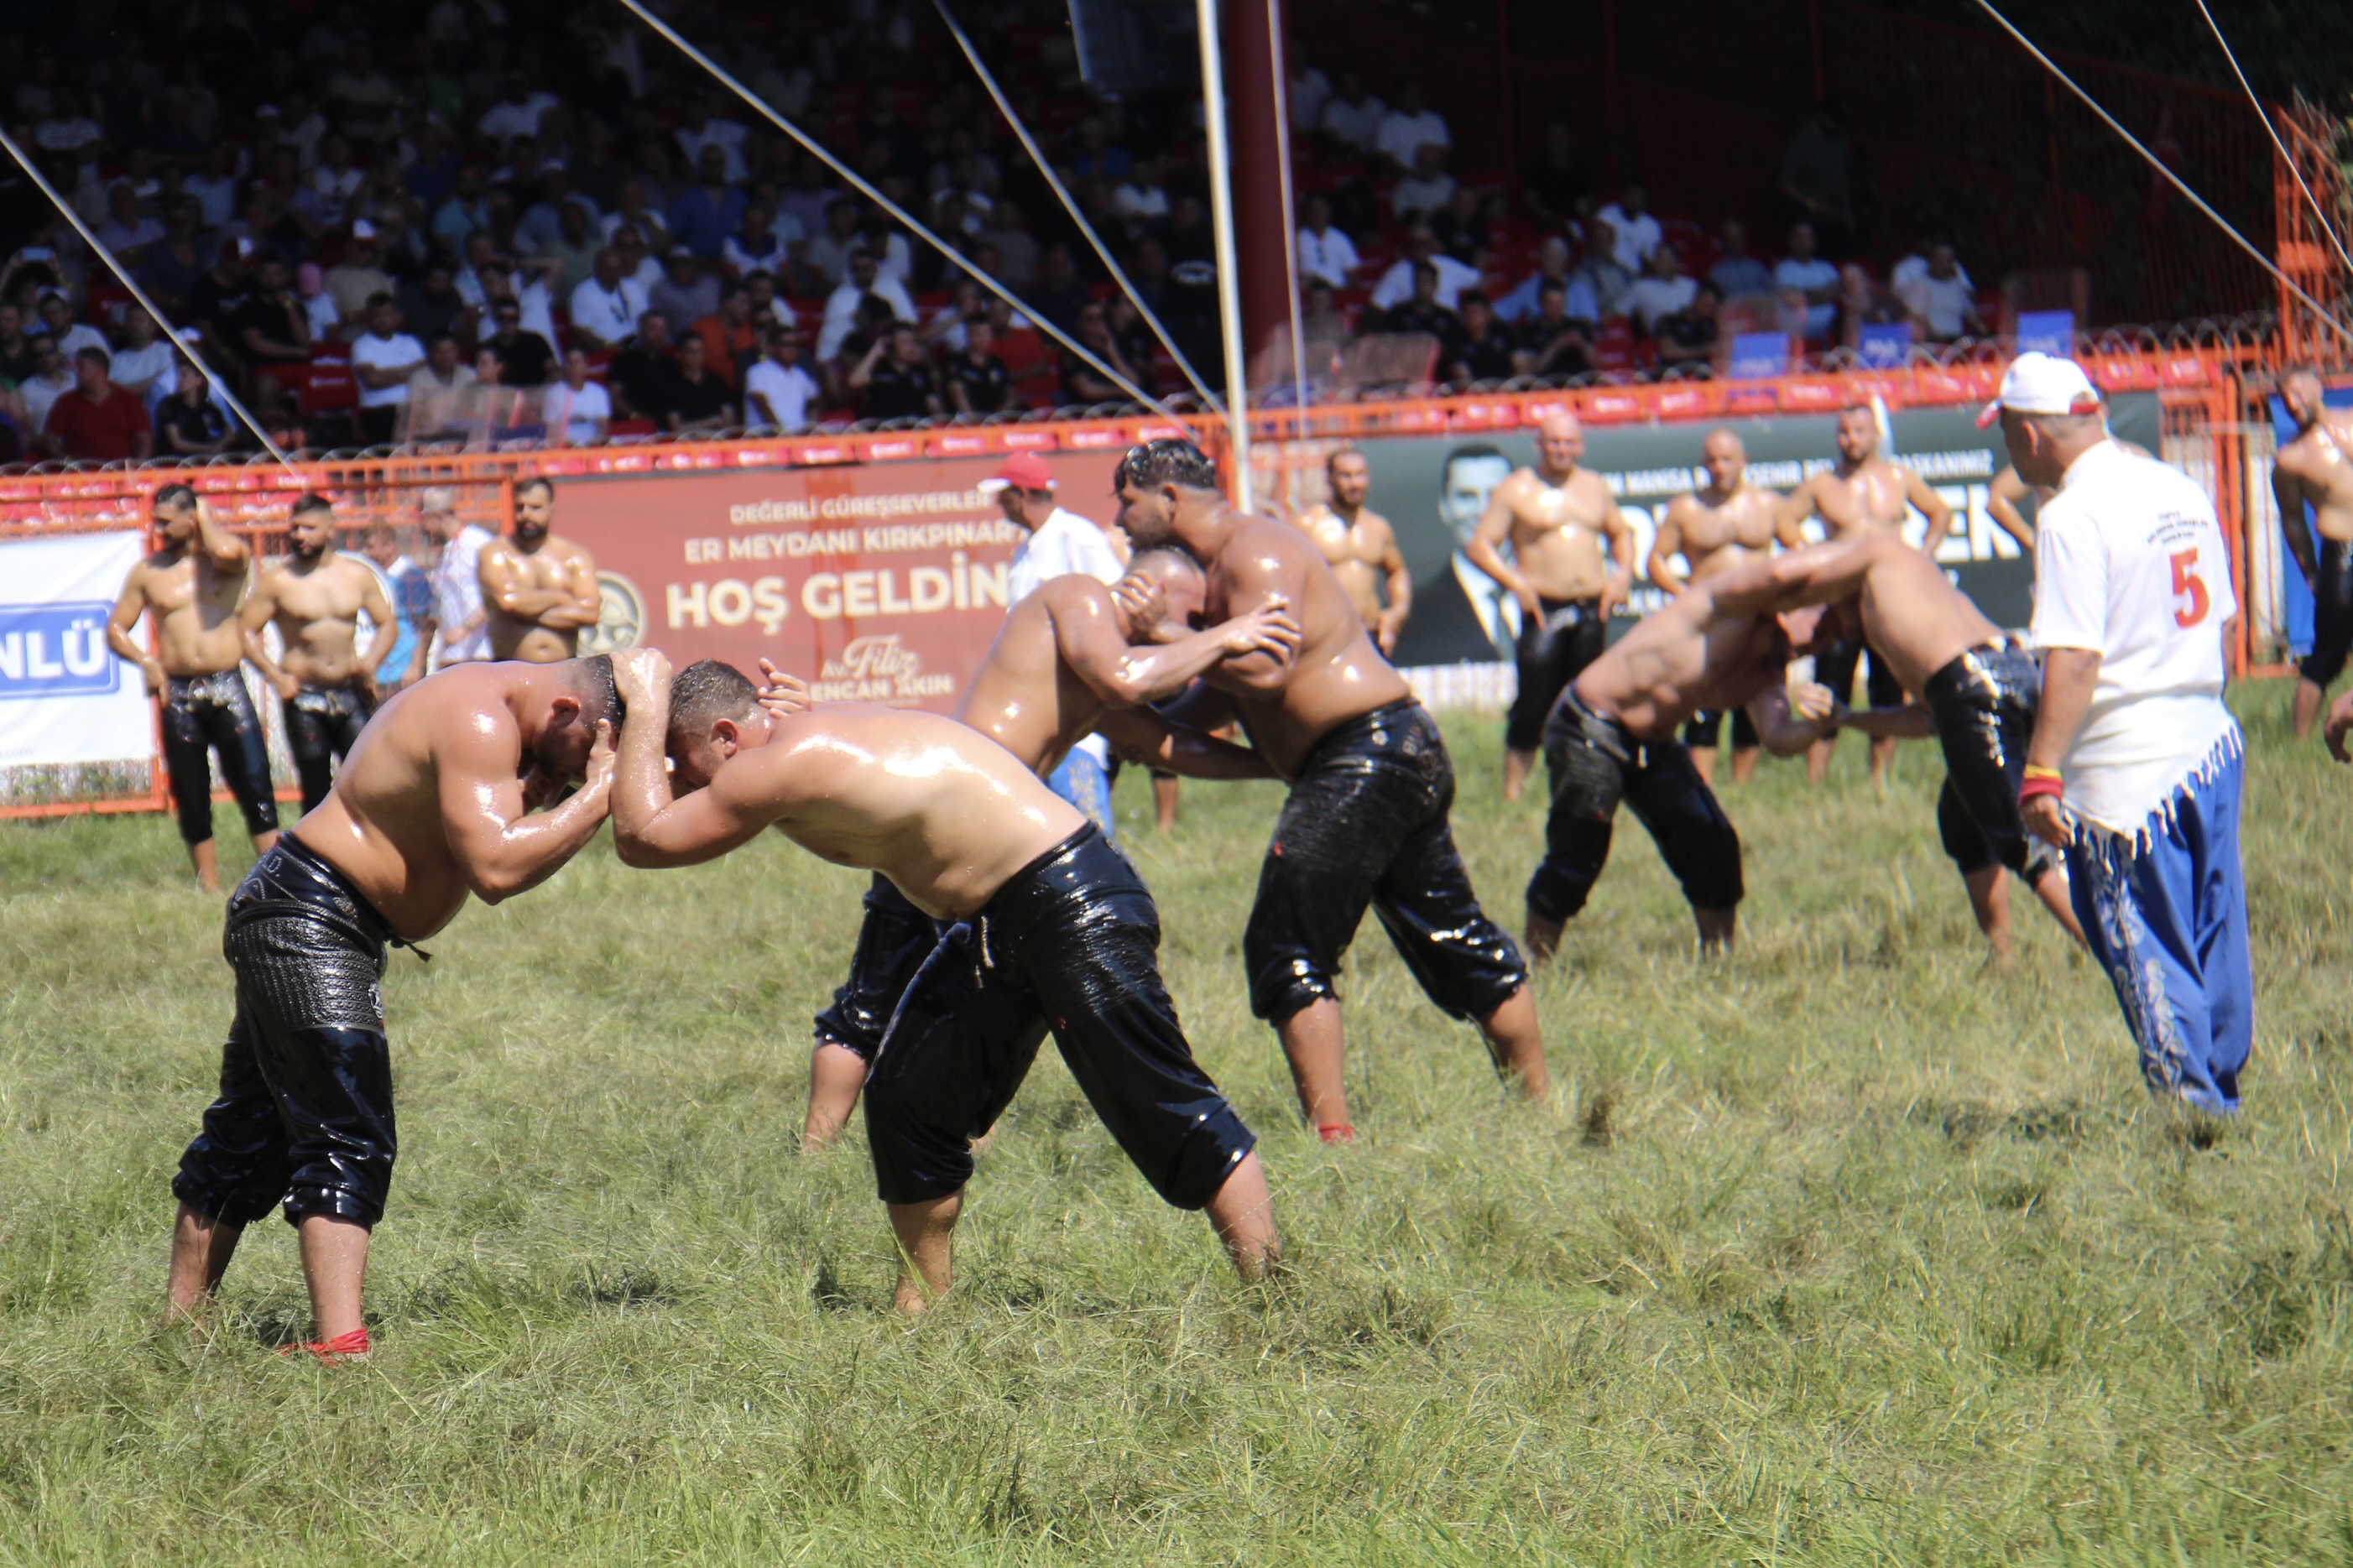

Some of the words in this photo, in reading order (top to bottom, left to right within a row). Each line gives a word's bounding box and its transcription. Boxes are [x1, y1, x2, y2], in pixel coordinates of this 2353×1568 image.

[730, 497, 817, 524] DEĞERLİ
[684, 537, 721, 565] ER
[728, 528, 857, 560] MEYDANI
[863, 518, 1019, 552] KIRKPINAR
[666, 576, 790, 635] HOŞ
[801, 550, 1010, 619] GELDİN
[2169, 548, 2210, 628] 5
[809, 679, 890, 702] ENCAN
